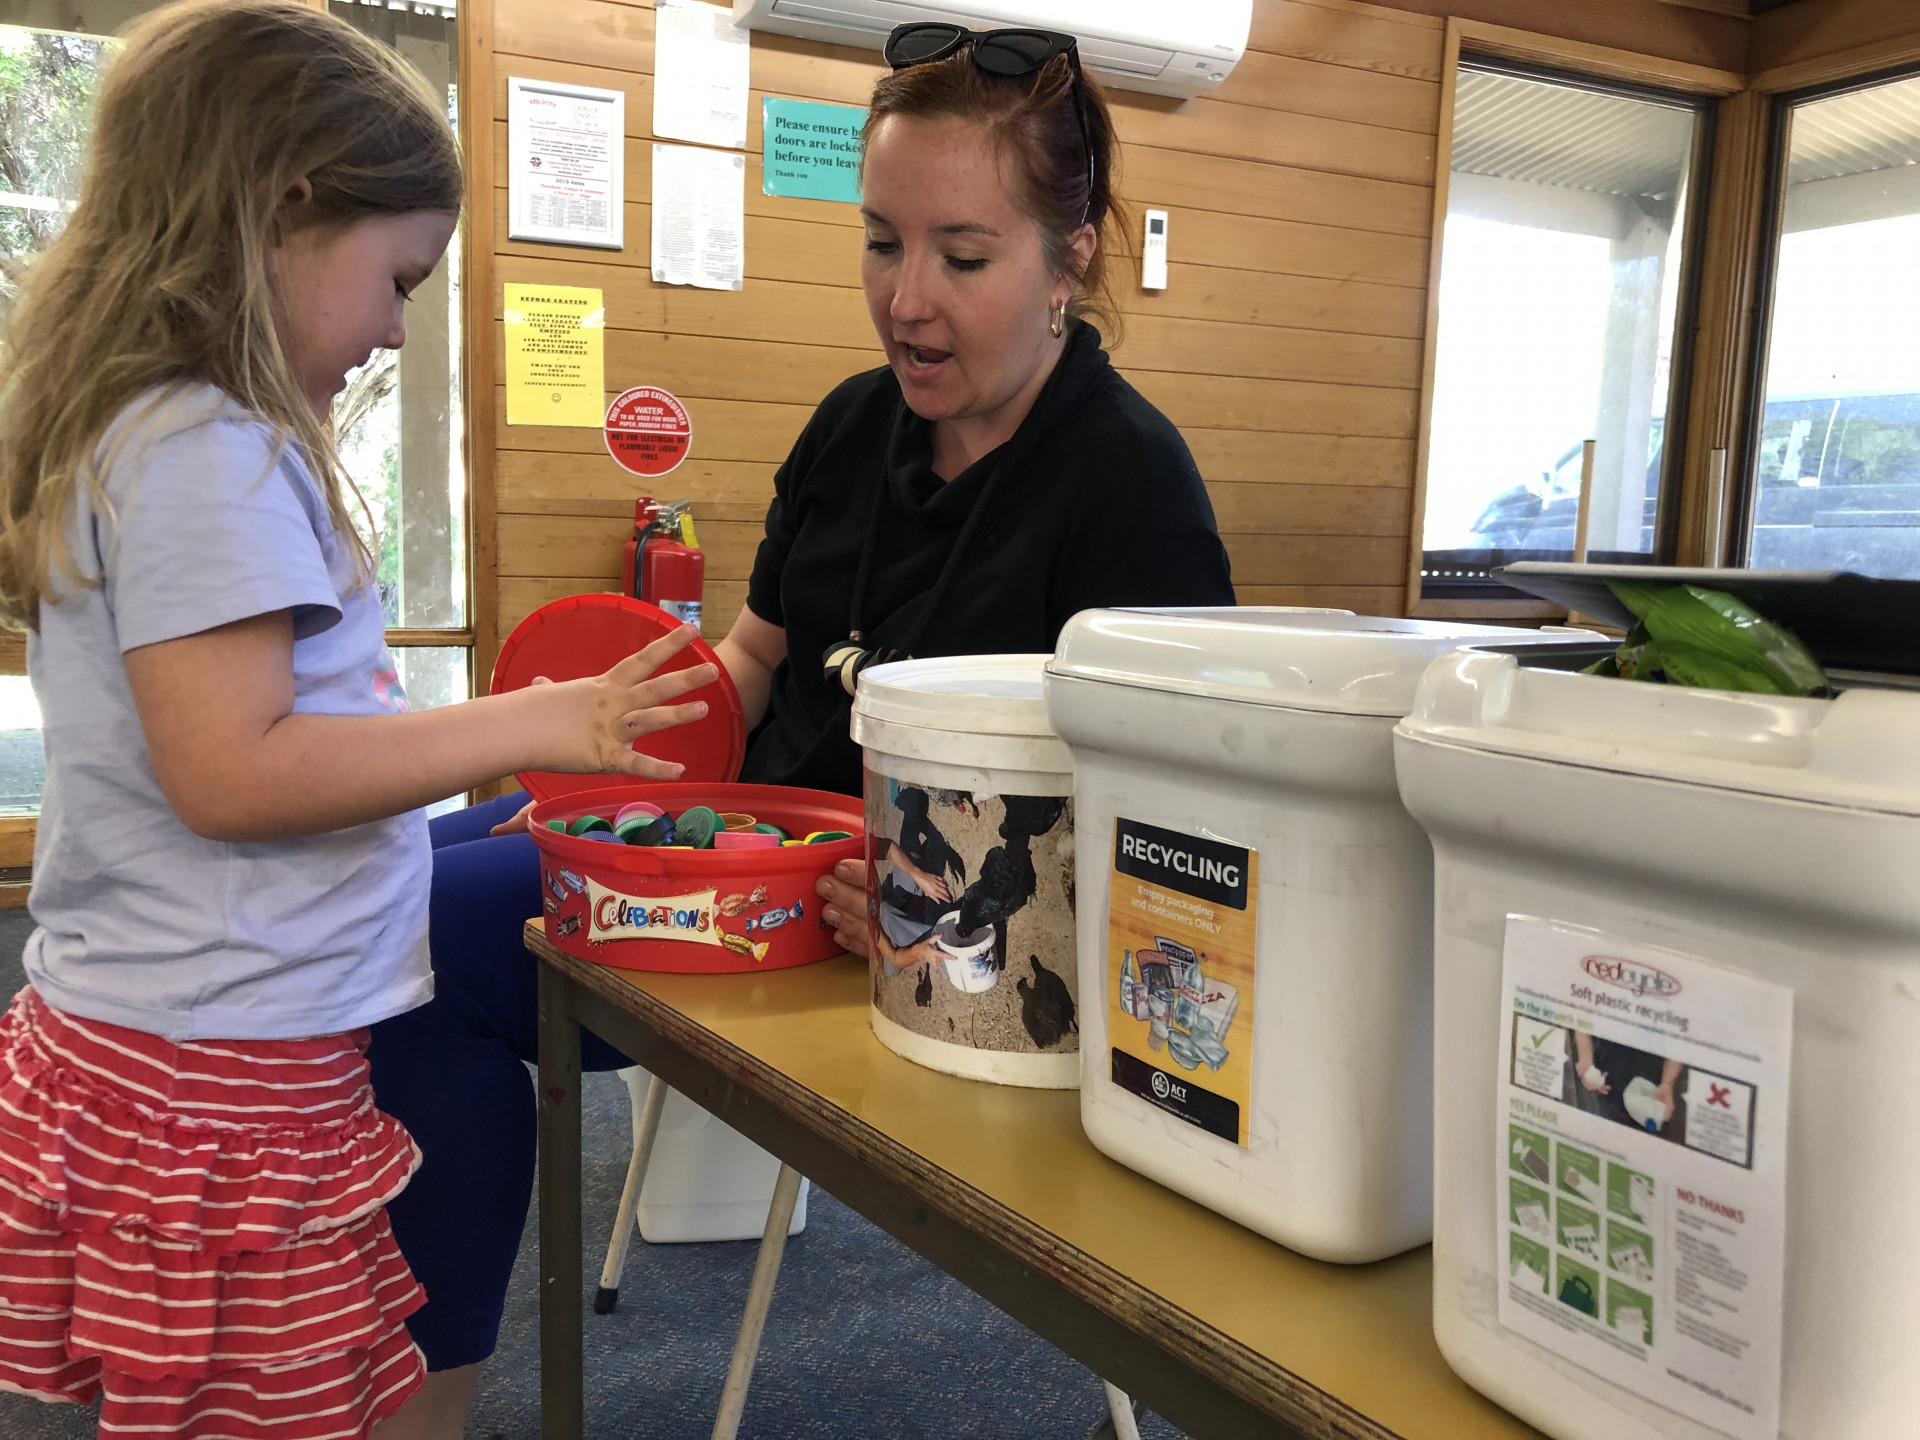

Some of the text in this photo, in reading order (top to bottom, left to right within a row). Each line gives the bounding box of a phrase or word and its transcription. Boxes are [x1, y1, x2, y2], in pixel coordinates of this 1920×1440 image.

[776, 117, 810, 131] Please
[812, 125, 849, 136] ensure
[775, 134, 806, 147] doors
[809, 140, 827, 150] are
[775, 150, 858, 168] before you leav
[775, 170, 794, 178] Thank
[609, 390, 687, 426] THIS COLOURED EXTINGUISHER
[634, 406, 664, 415] WATER
[619, 443, 655, 451] FLAMMABLE
[641, 435, 674, 443] ELECTRICAL
[1122, 834, 1239, 887] RECYCLING
[1138, 885, 1214, 920] Empty packaging
[1131, 898, 1221, 934] and containers ONLY
[1183, 984, 1200, 997] SOFT
[1202, 992, 1226, 1004] ZA
[1571, 983, 1592, 1001] Soft
[1595, 992, 1632, 1013] plastic
[1636, 1005, 1688, 1032] recycling
[1171, 1084, 1186, 1098] ACT
[1509, 1097, 1558, 1124] YES PLEASE
[1677, 1188, 1695, 1204] NO
[1698, 1195, 1744, 1224] THANKS
